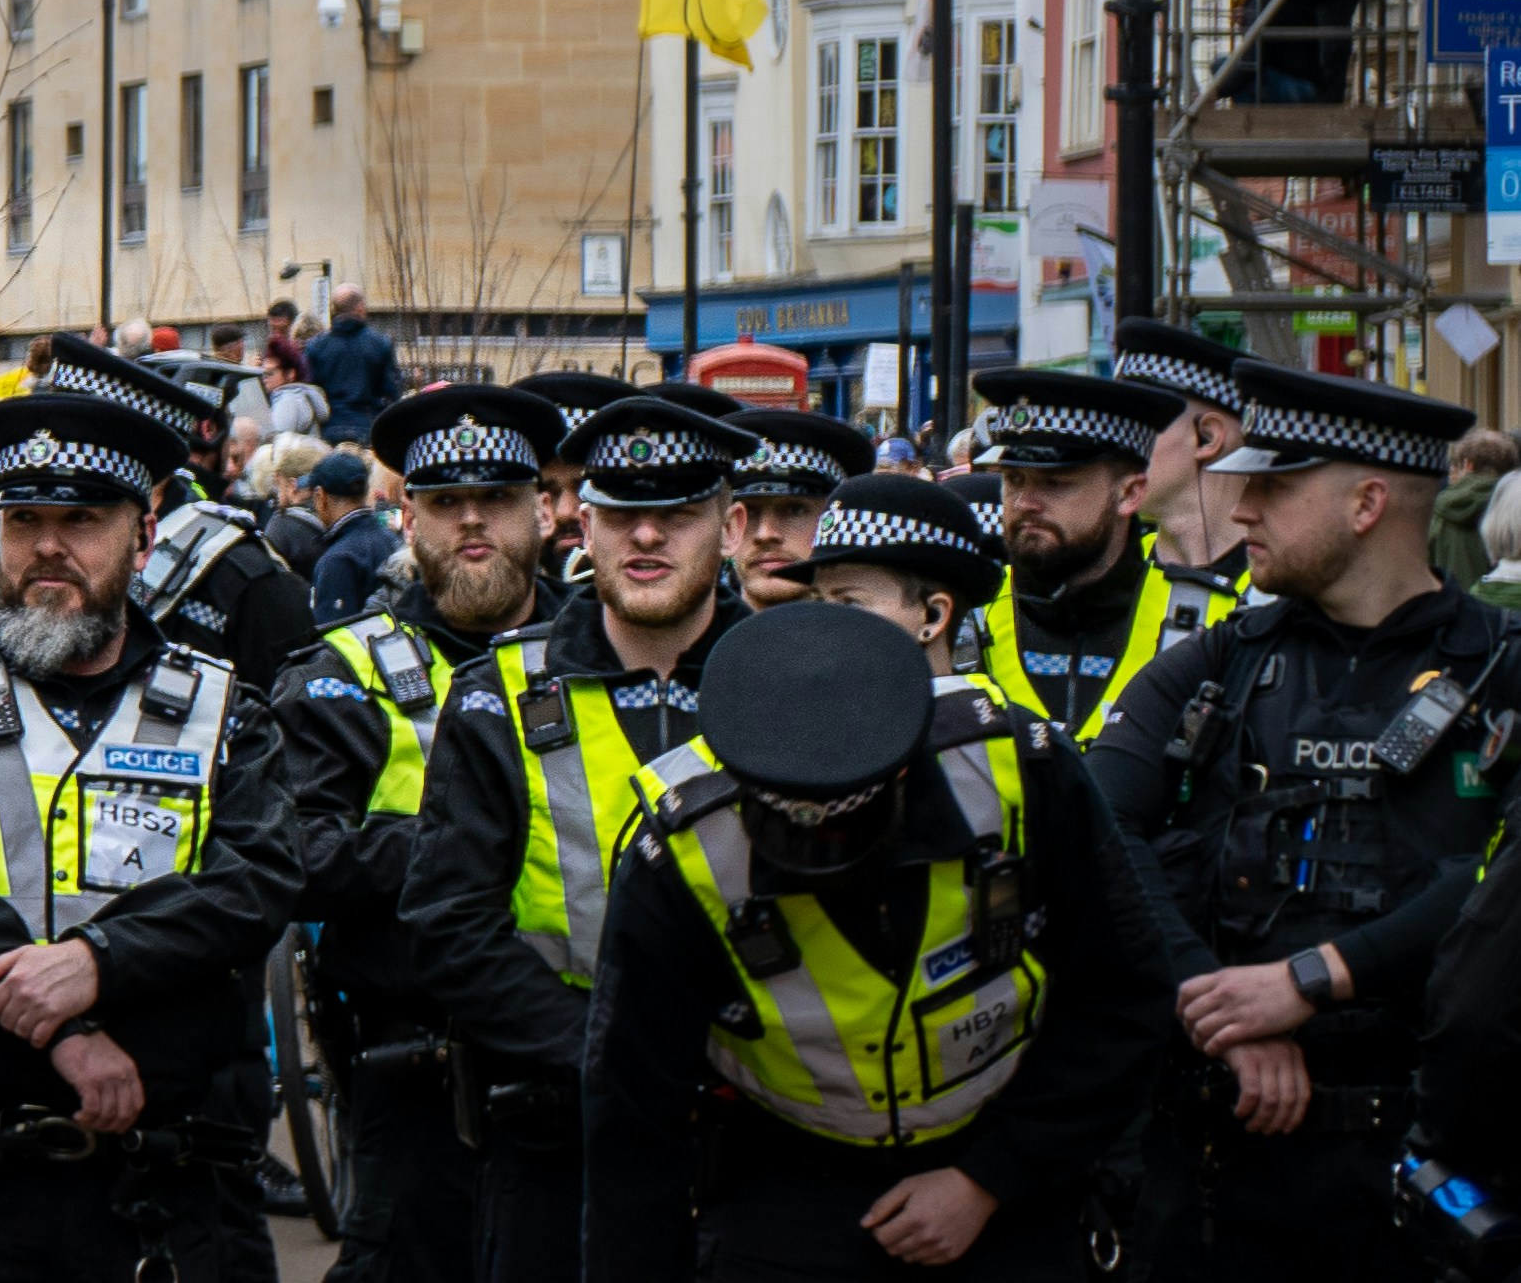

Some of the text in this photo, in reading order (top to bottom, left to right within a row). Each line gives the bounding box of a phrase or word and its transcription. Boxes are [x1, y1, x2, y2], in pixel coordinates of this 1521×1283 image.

[109, 750, 196, 772] POLICE
[99, 801, 179, 838] HBS2
[122, 847, 144, 870] A
[930, 945, 972, 974] POL
